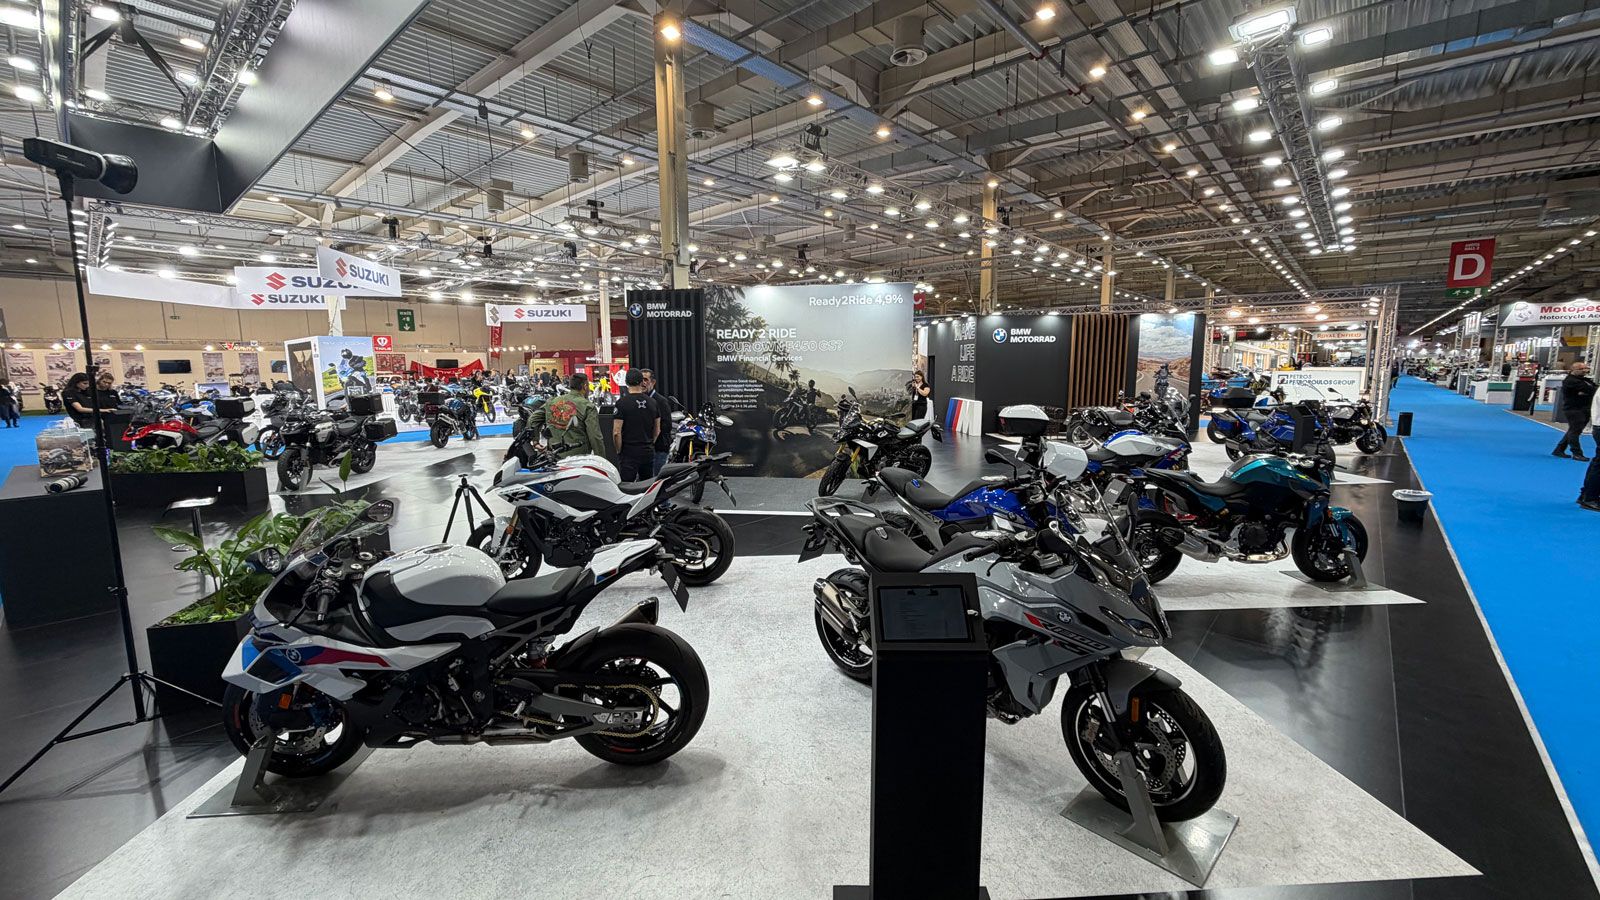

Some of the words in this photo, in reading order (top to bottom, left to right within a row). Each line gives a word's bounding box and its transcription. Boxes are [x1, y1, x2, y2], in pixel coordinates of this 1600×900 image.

[1453, 253, 1486, 281] D
[349, 263, 389, 287] SUZUKI
[268, 294, 325, 304] SUZUKI
[809, 295, 872, 307] Ready2Ride
[875, 294, 904, 305] 4,9%
[527, 309, 572, 318] SUZUKI
[646, 310, 693, 318] MOTORRAD
[716, 329, 754, 339] READY
[758, 329, 766, 338] 2
[769, 328, 797, 338] RIDE
[1010, 335, 1057, 343] MOTORRAD
[716, 342, 752, 352] YOUR
[752, 341, 784, 352] OWN
[738, 354, 771, 362] Financial
[771, 354, 803, 362] Services
[959, 344, 975, 361] LIFE
